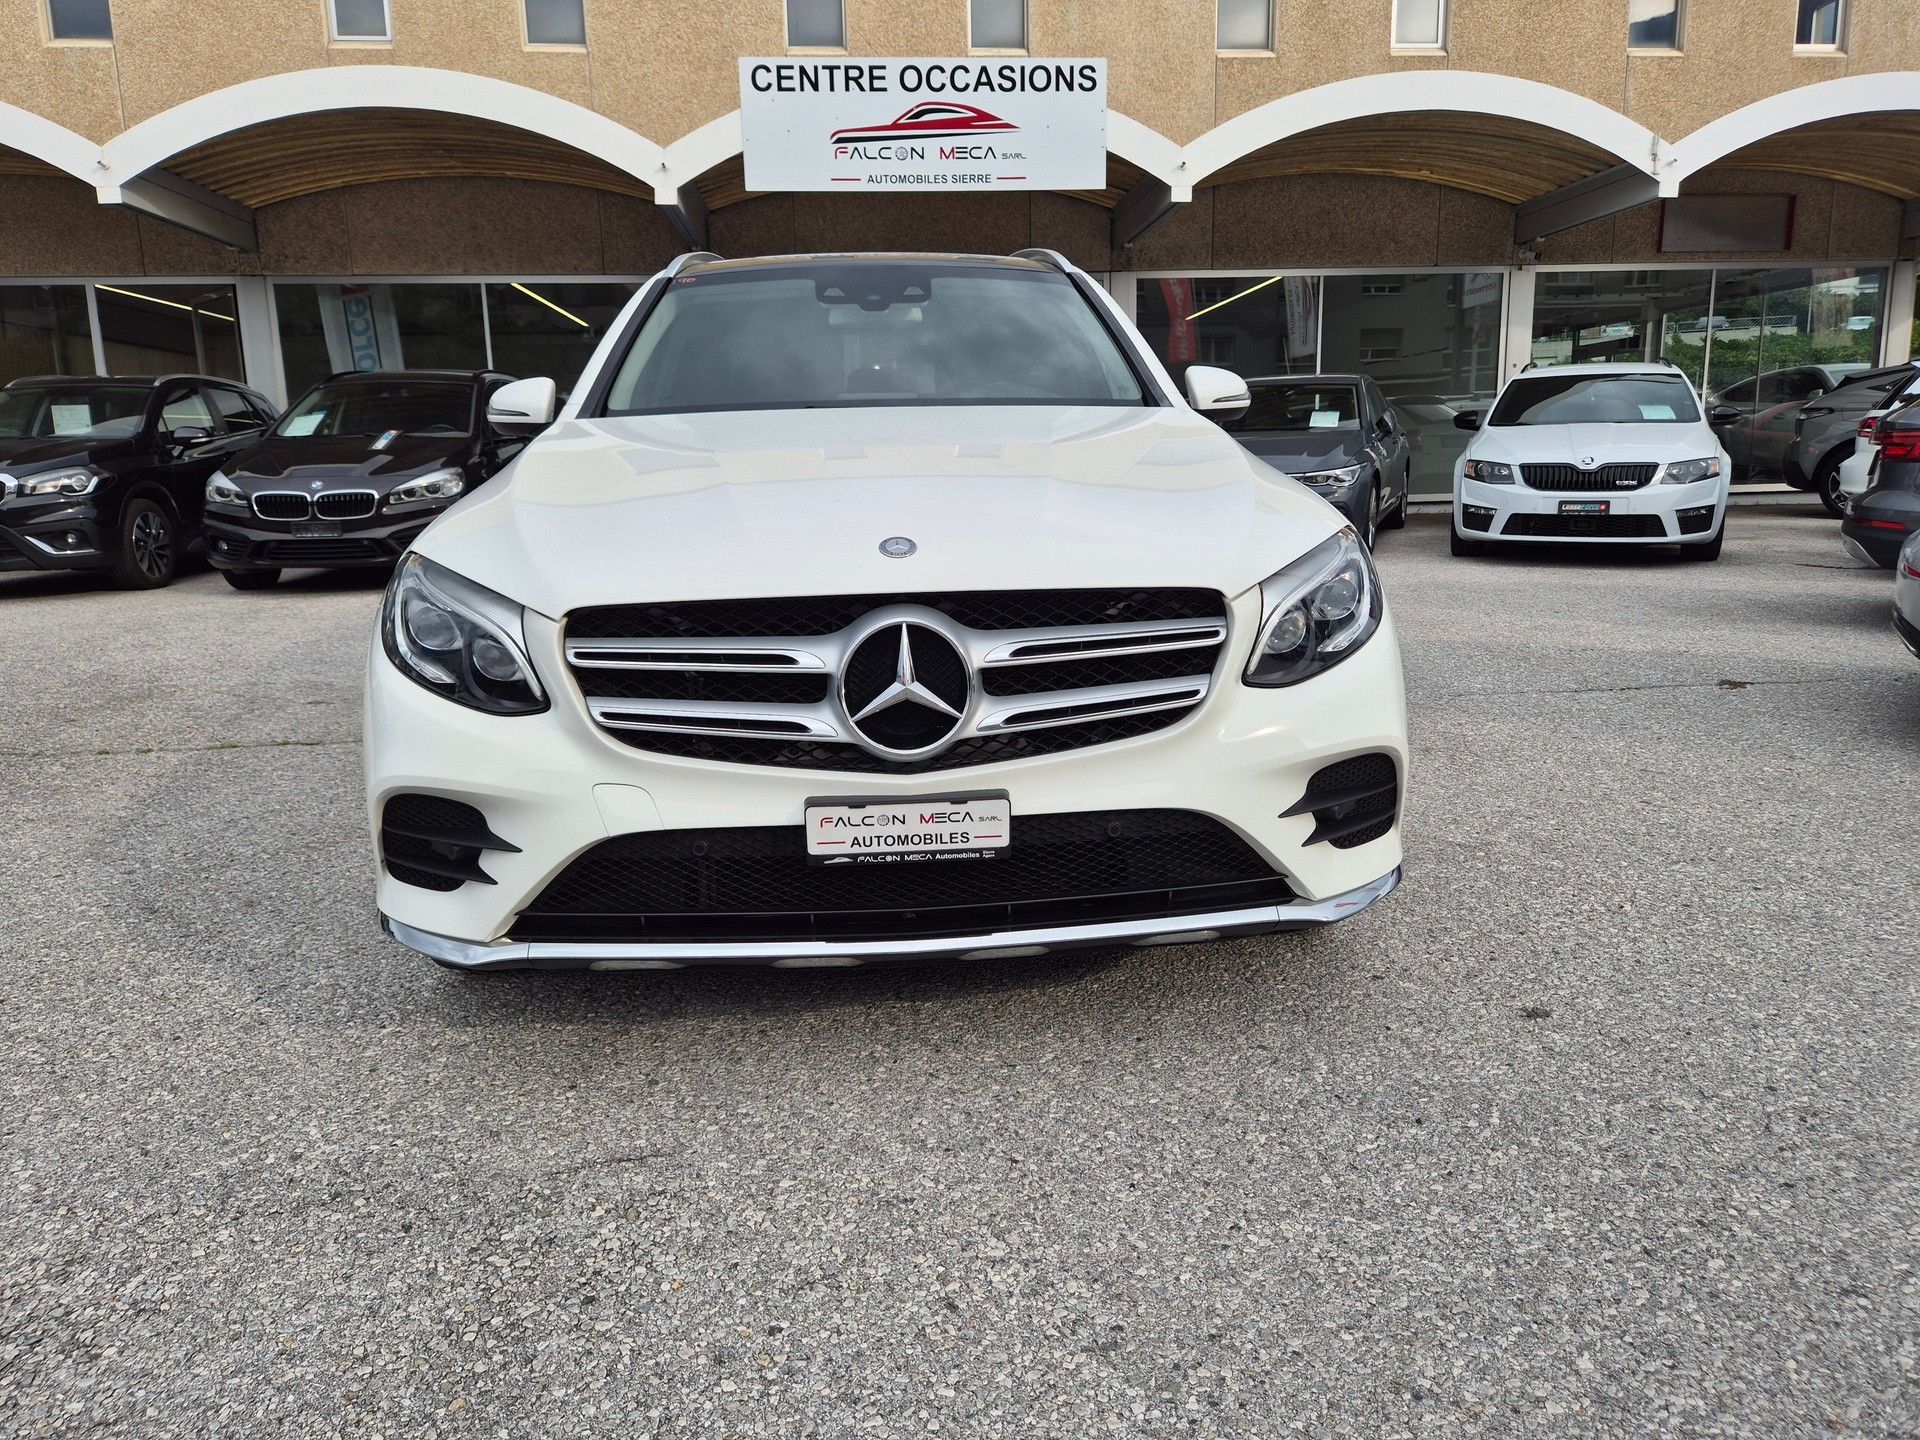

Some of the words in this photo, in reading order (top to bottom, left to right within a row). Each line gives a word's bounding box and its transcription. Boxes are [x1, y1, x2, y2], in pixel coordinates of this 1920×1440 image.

[751, 64, 887, 92] CENTRE
[899, 64, 1097, 92] OCCASIONS
[834, 146, 925, 161] FALCON
[939, 146, 997, 160] MECA
[867, 174, 948, 184] AUTOMOBILES
[951, 173, 992, 183] SIERRE
[820, 814, 906, 828] FALCON
[920, 811, 974, 824] MECA
[850, 831, 970, 848] AUTOMOBILES
[904, 853, 933, 861] MECA
[935, 851, 980, 860] Automobiles
